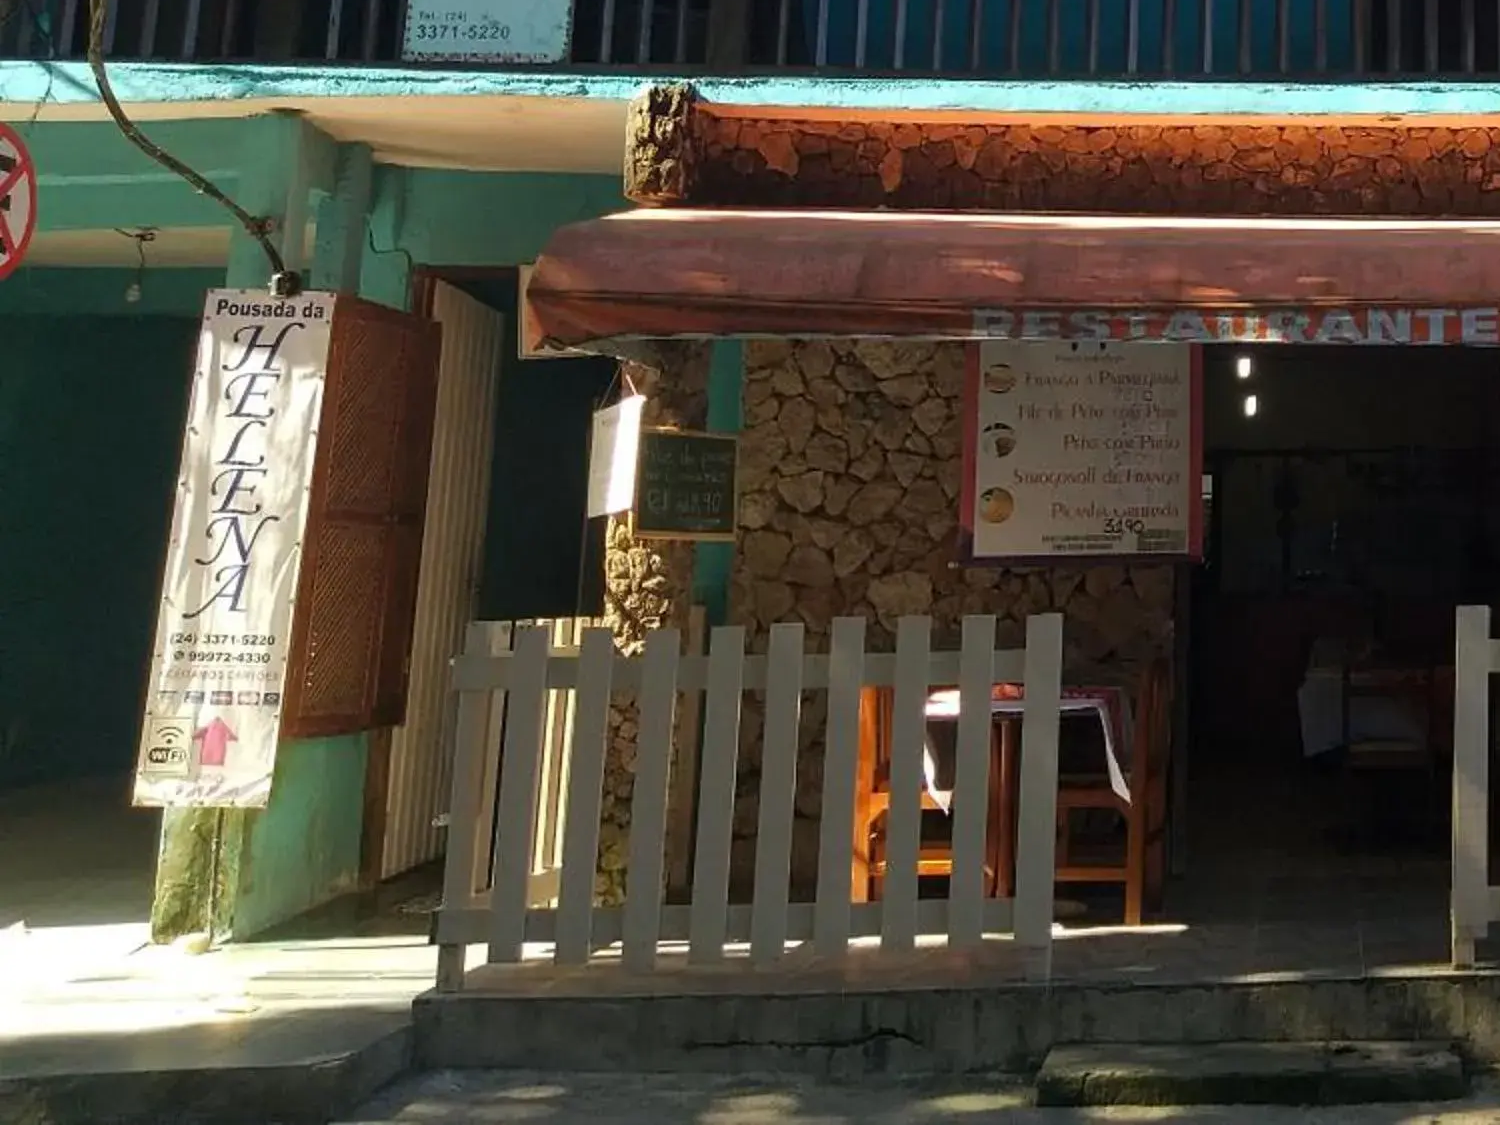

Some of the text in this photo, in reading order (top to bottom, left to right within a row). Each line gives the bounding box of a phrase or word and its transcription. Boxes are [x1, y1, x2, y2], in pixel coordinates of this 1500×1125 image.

[416, 25, 511, 41] 3371-5220
[216, 299, 325, 319] Pousada da
[972, 307, 1498, 343] RESTAURANTE
[183, 321, 305, 619] HELENA
[203, 634, 275, 646] 3371-5220
